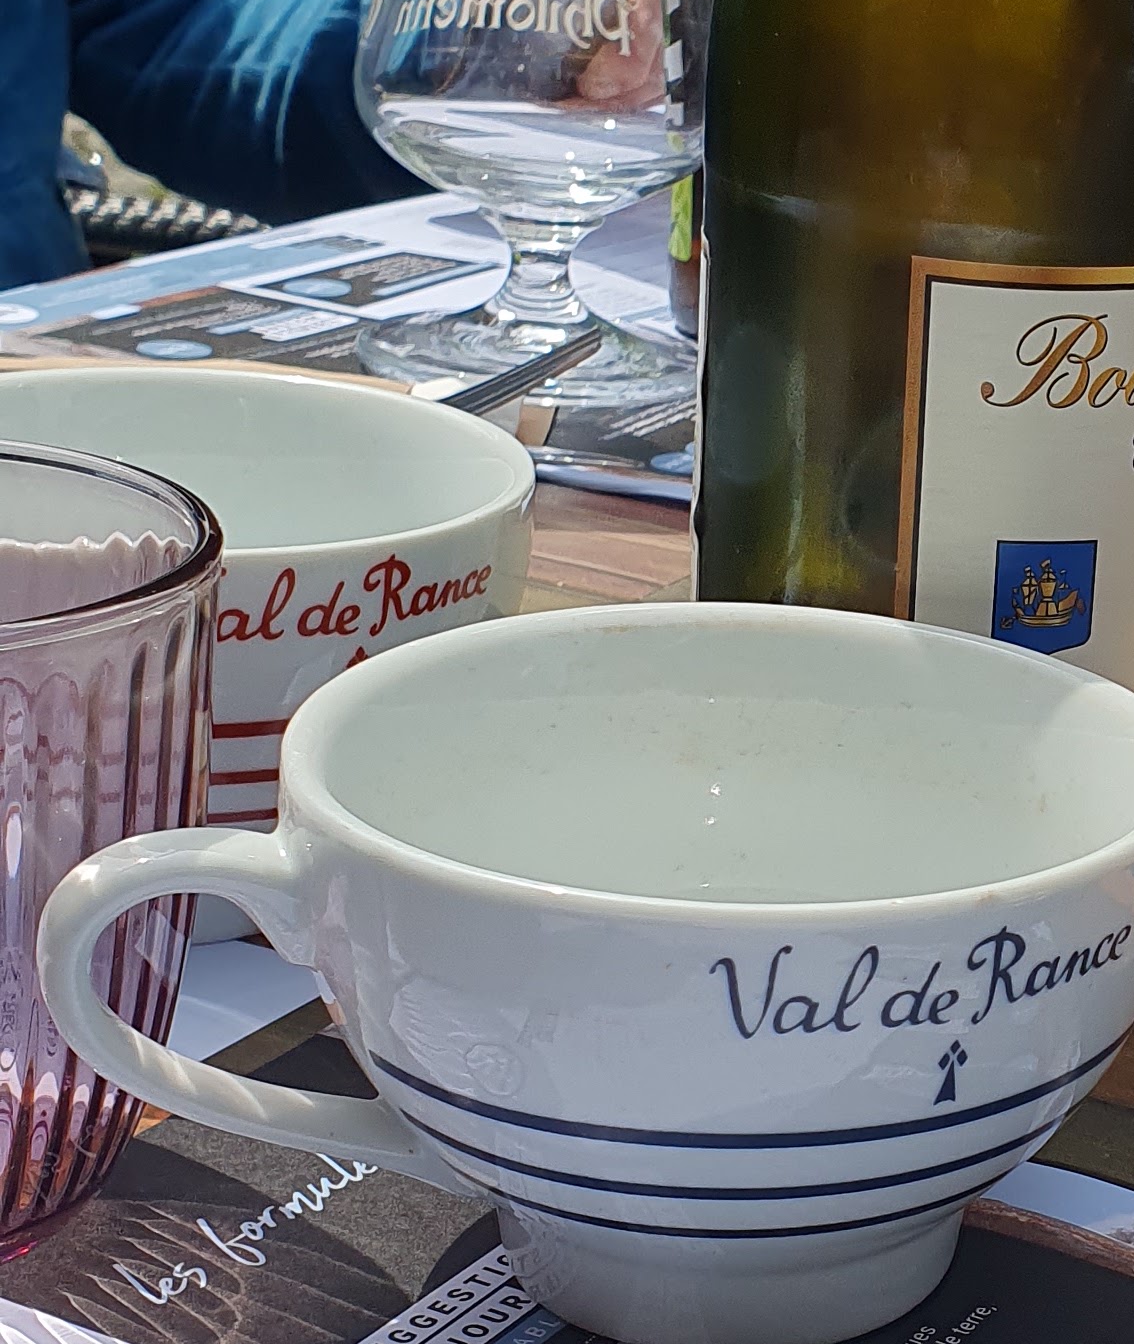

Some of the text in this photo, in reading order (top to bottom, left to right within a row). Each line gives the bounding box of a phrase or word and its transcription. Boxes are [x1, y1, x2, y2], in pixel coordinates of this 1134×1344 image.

[216, 553, 492, 642] al de Rance
[708, 923, 1132, 1040] Val de Rance
